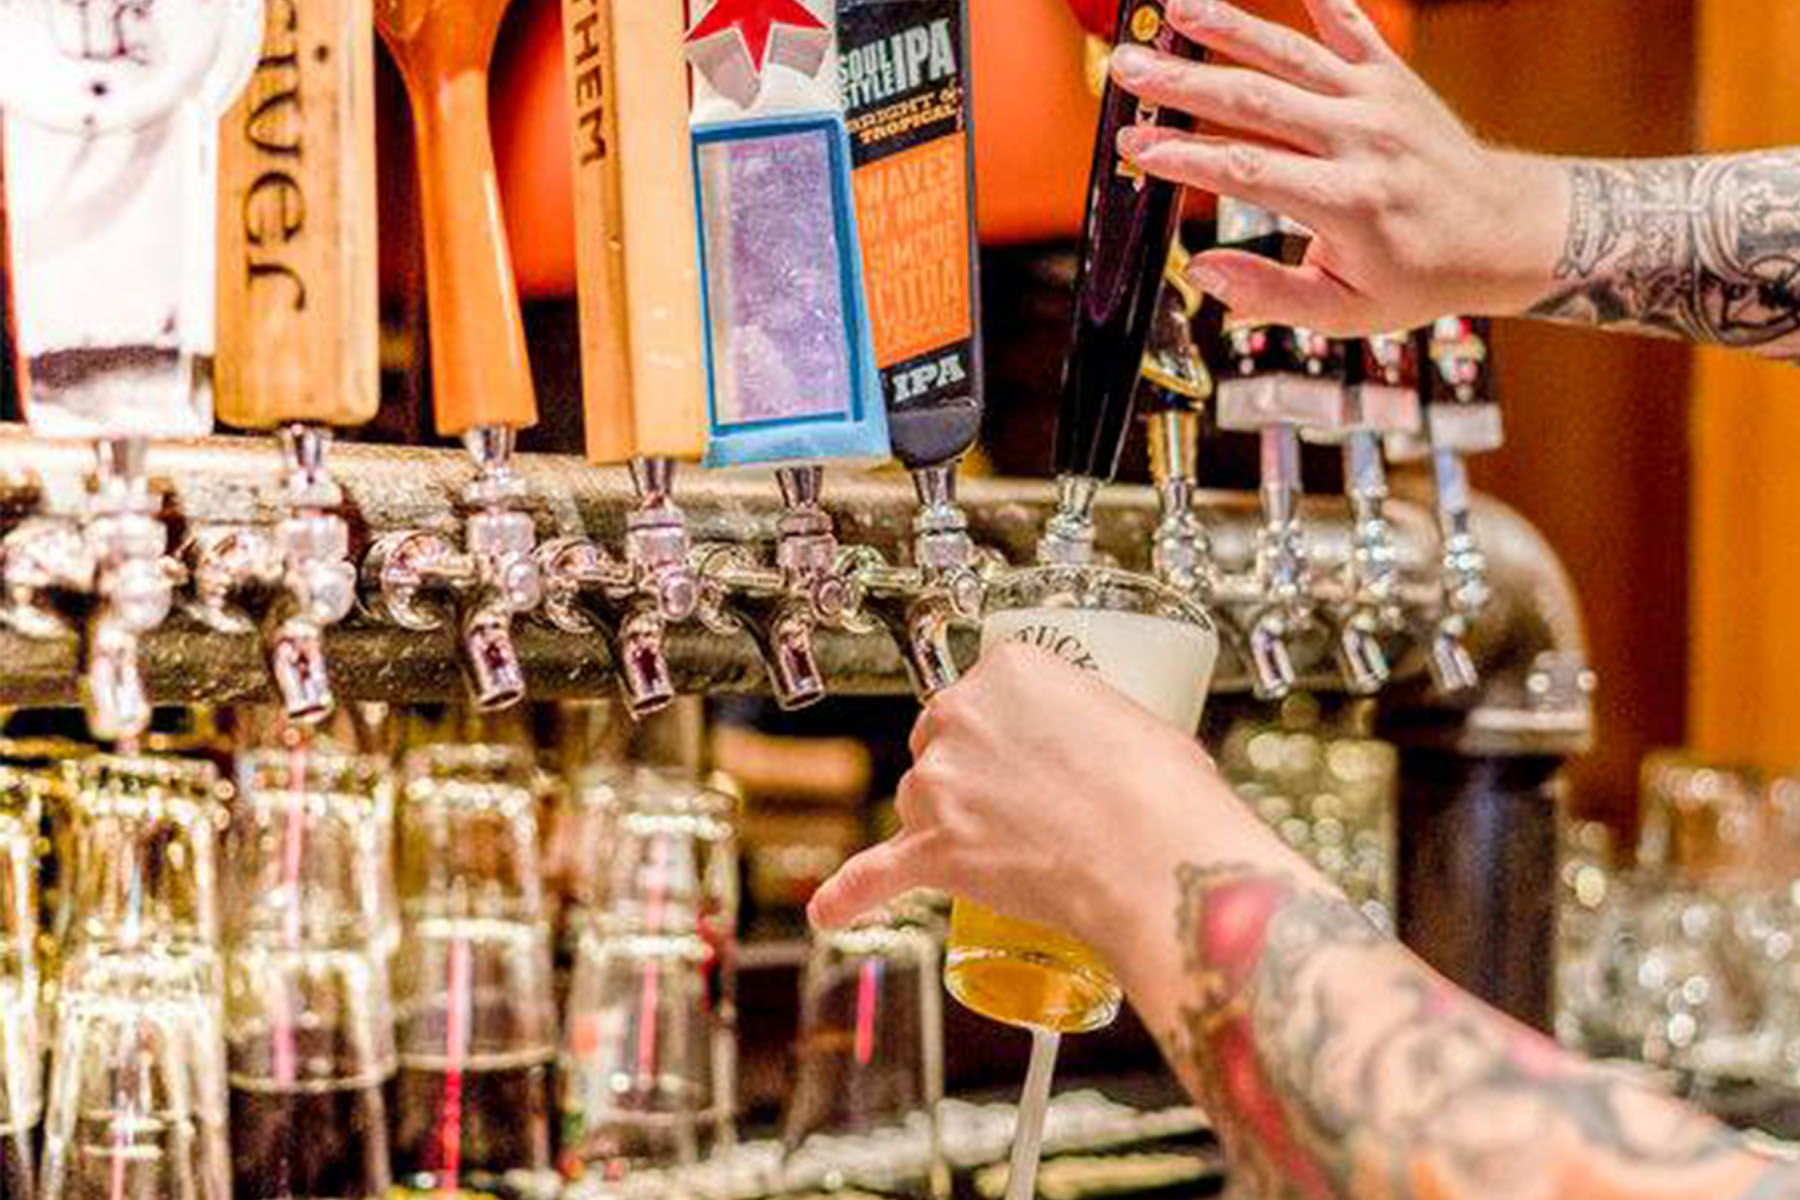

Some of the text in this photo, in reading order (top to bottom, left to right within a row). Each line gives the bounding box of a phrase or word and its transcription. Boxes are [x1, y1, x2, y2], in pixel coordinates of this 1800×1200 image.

[836, 38, 893, 86] SOUL
[890, 17, 957, 93] IPA
[573, 0, 607, 167] HEM
[837, 63, 895, 112] STYLE
[858, 103, 957, 145] TROPICAL
[855, 144, 958, 205] WAVES
[892, 354, 966, 403] IPA
[1004, 625, 1099, 671] TUCK
